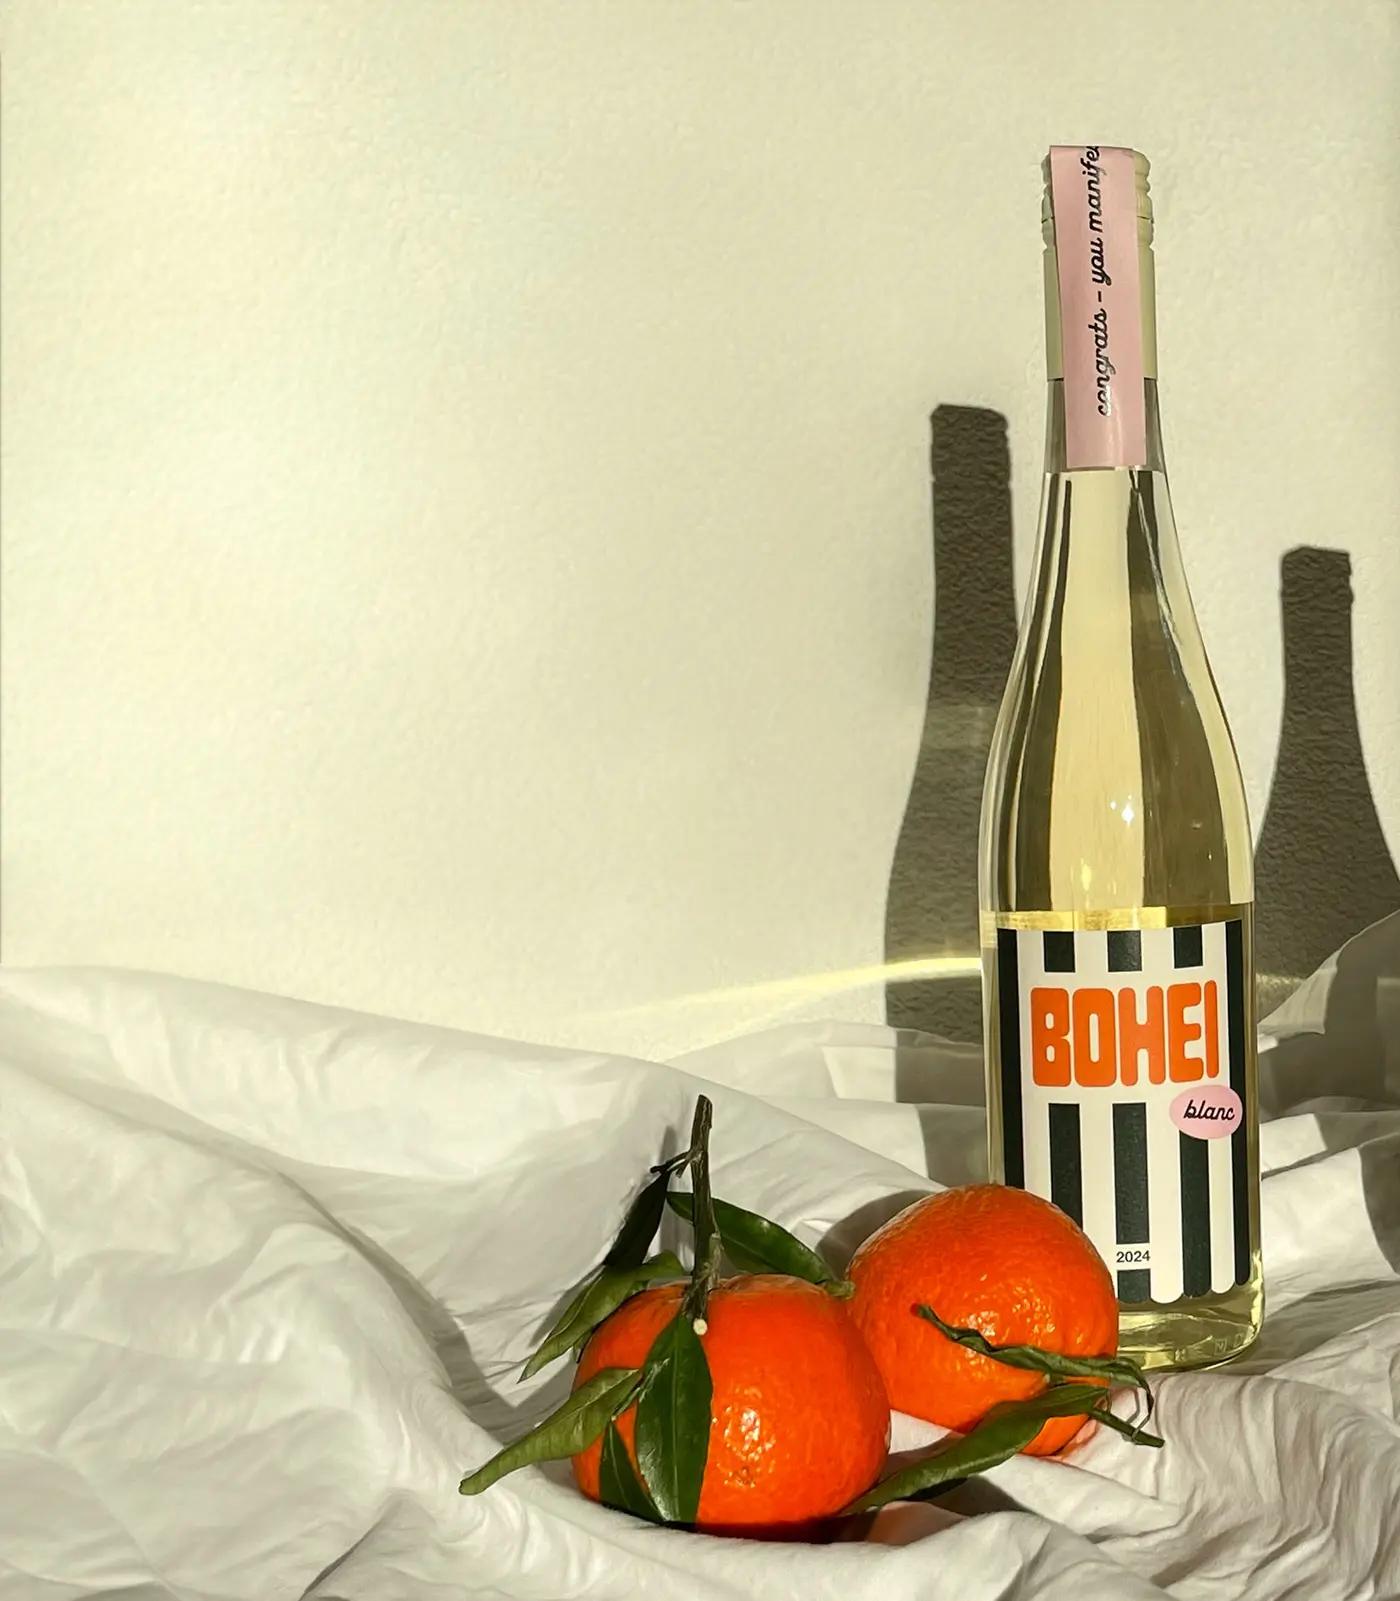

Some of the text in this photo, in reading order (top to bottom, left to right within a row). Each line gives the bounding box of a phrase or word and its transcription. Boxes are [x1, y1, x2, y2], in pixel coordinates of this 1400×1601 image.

[1090, 237, 1112, 286] you
[1088, 308, 1116, 417] congrats
[1030, 980, 1219, 1087] BOHEI
[1183, 1099, 1235, 1121] blanc
[1116, 1250, 1151, 1264] 2024
